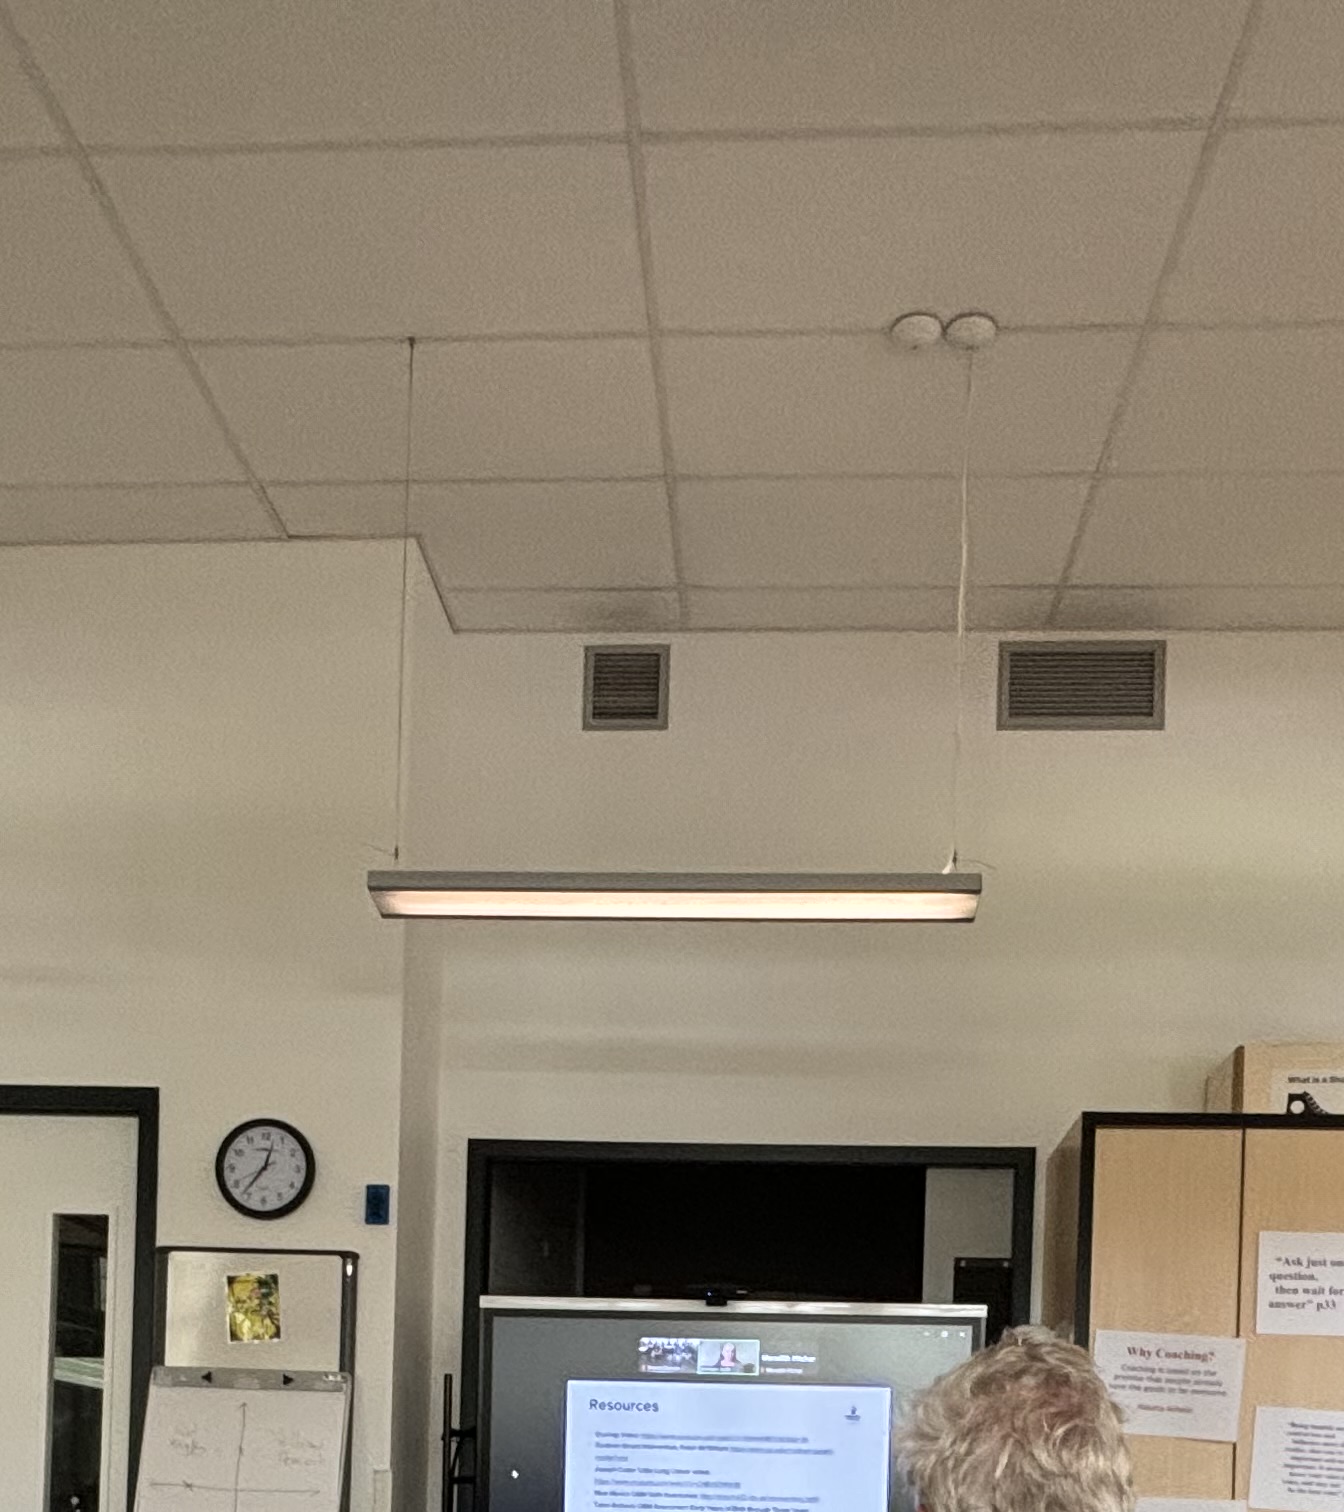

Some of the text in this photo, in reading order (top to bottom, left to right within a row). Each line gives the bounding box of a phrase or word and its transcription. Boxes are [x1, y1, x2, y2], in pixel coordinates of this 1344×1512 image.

[1305, 1257, 1327, 1268] just
[1275, 1285, 1298, 1294] then
[1302, 1286, 1325, 1295] wait
[1329, 1286, 1344, 1295] for
[589, 1398, 659, 1413] Resources
